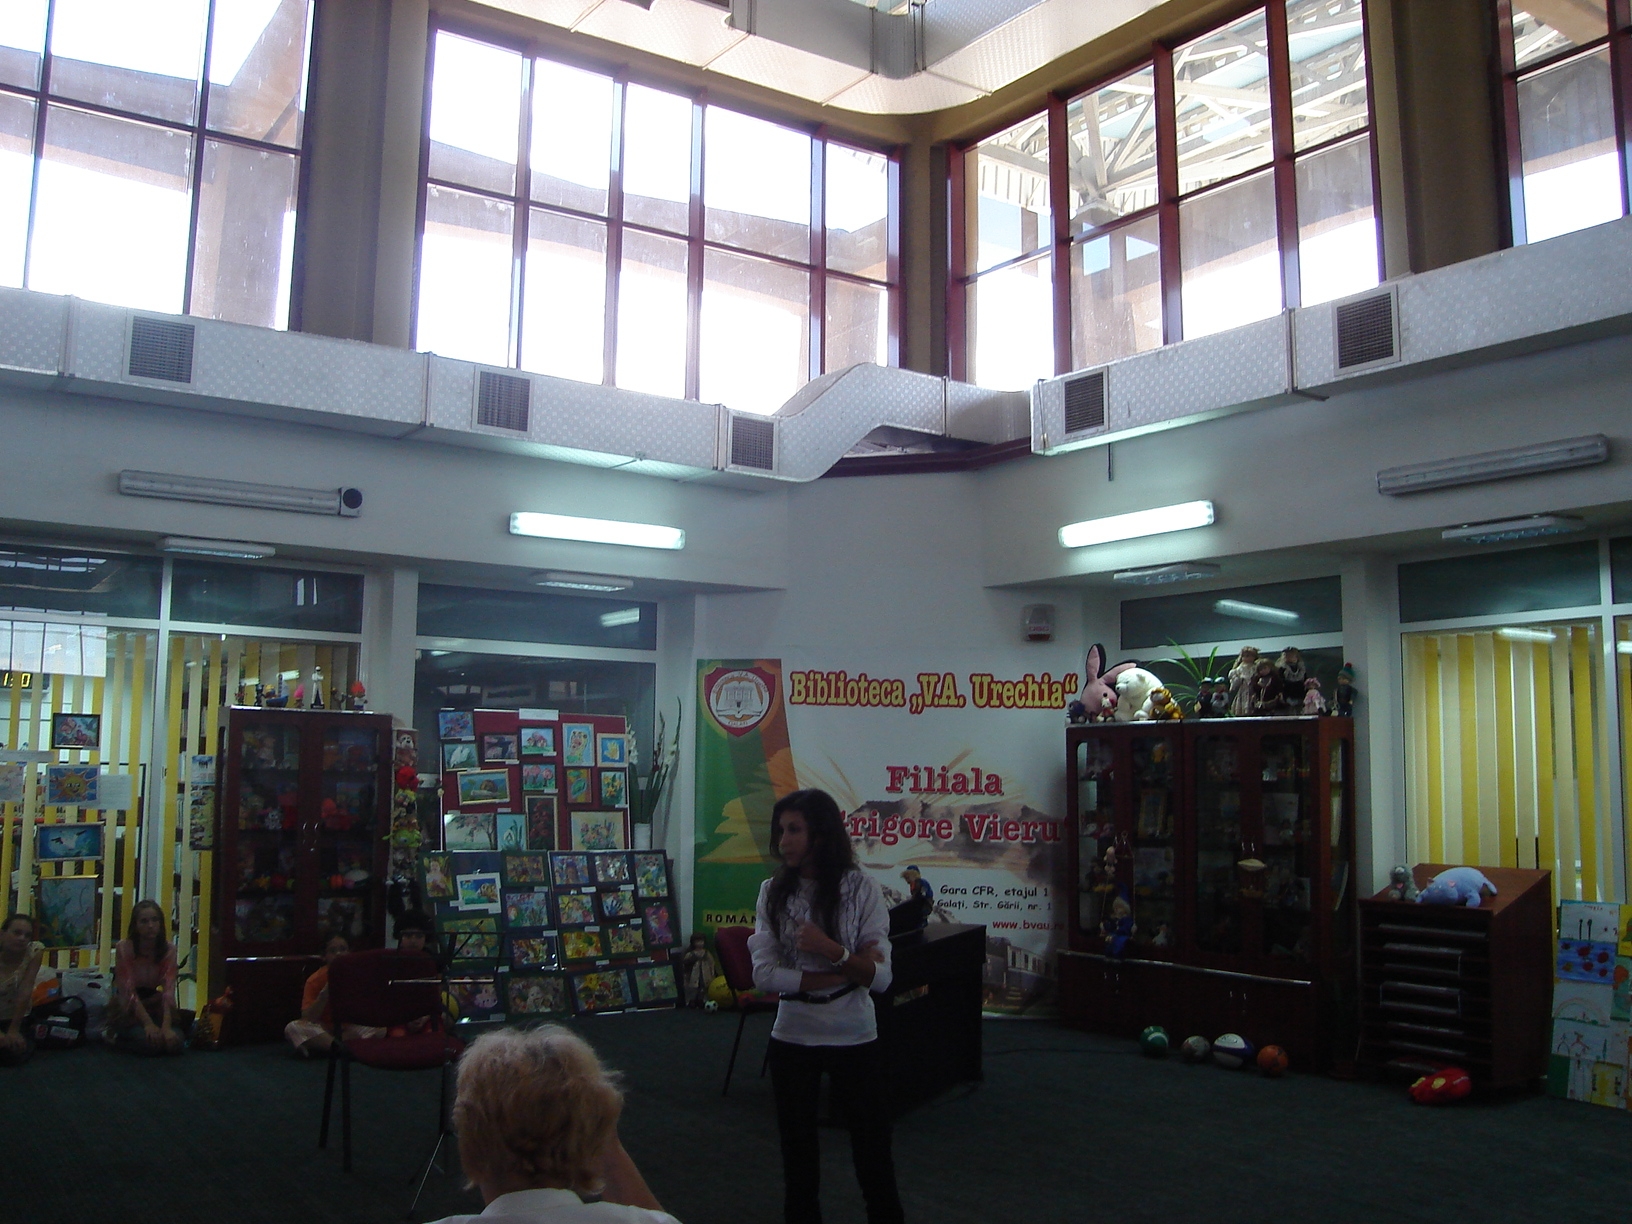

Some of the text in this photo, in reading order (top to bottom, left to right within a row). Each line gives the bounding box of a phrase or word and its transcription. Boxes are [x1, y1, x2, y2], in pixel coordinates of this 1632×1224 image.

[789, 669, 906, 707] Biblioteca
[885, 764, 1004, 796] Filiala
[842, 809, 1067, 845] rigore Vieru
[940, 884, 1048, 899] Gara CFR, etajul 1
[972, 900, 993, 910] Str.
[1047, 903, 1052, 911] 1
